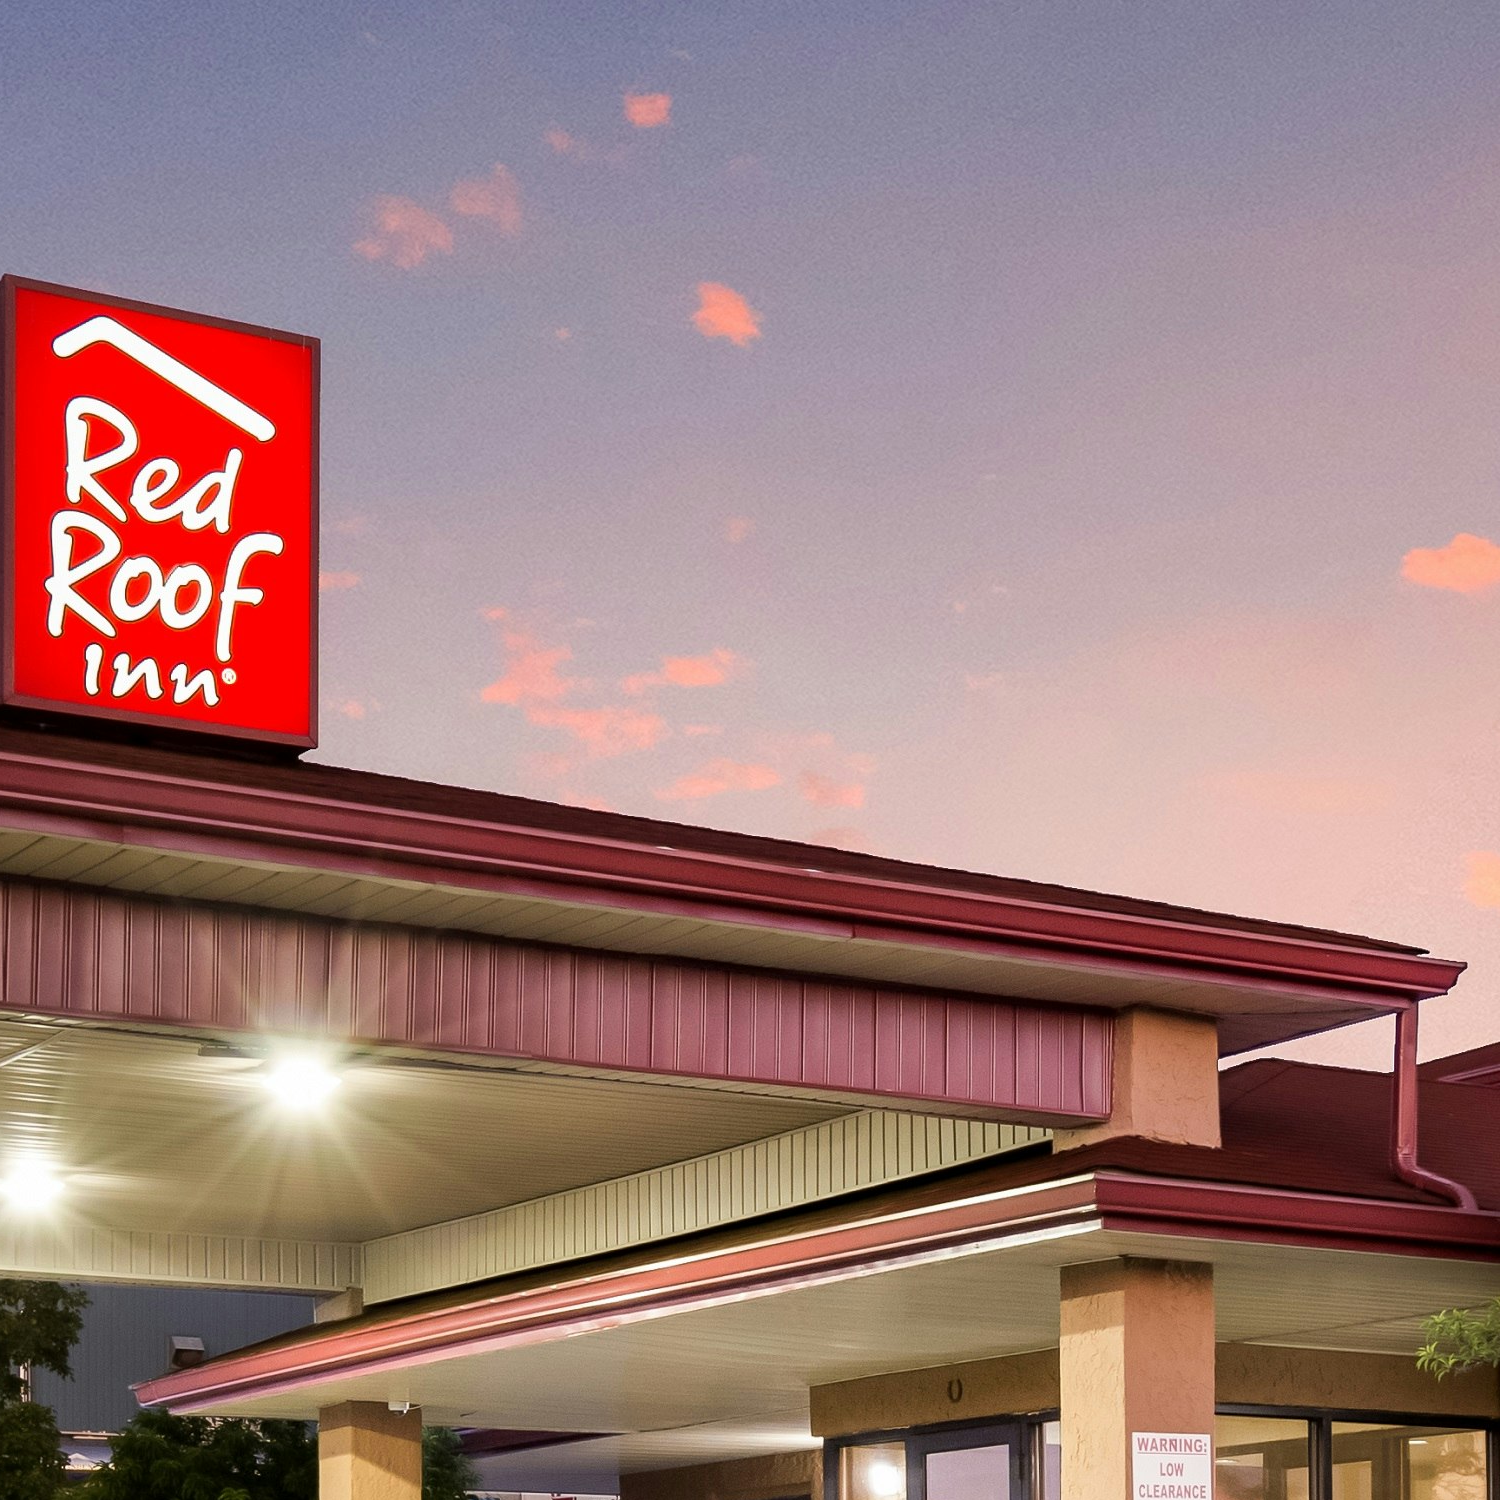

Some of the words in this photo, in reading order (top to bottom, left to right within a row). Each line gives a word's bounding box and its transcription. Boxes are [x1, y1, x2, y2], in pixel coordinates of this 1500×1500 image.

[65, 396, 243, 534] Red
[44, 510, 284, 662] Roof
[1137, 1437, 1207, 1453] WARNING:
[1160, 1463, 1184, 1477] LOW
[1139, 1484, 1206, 1499] CLEARANCE
